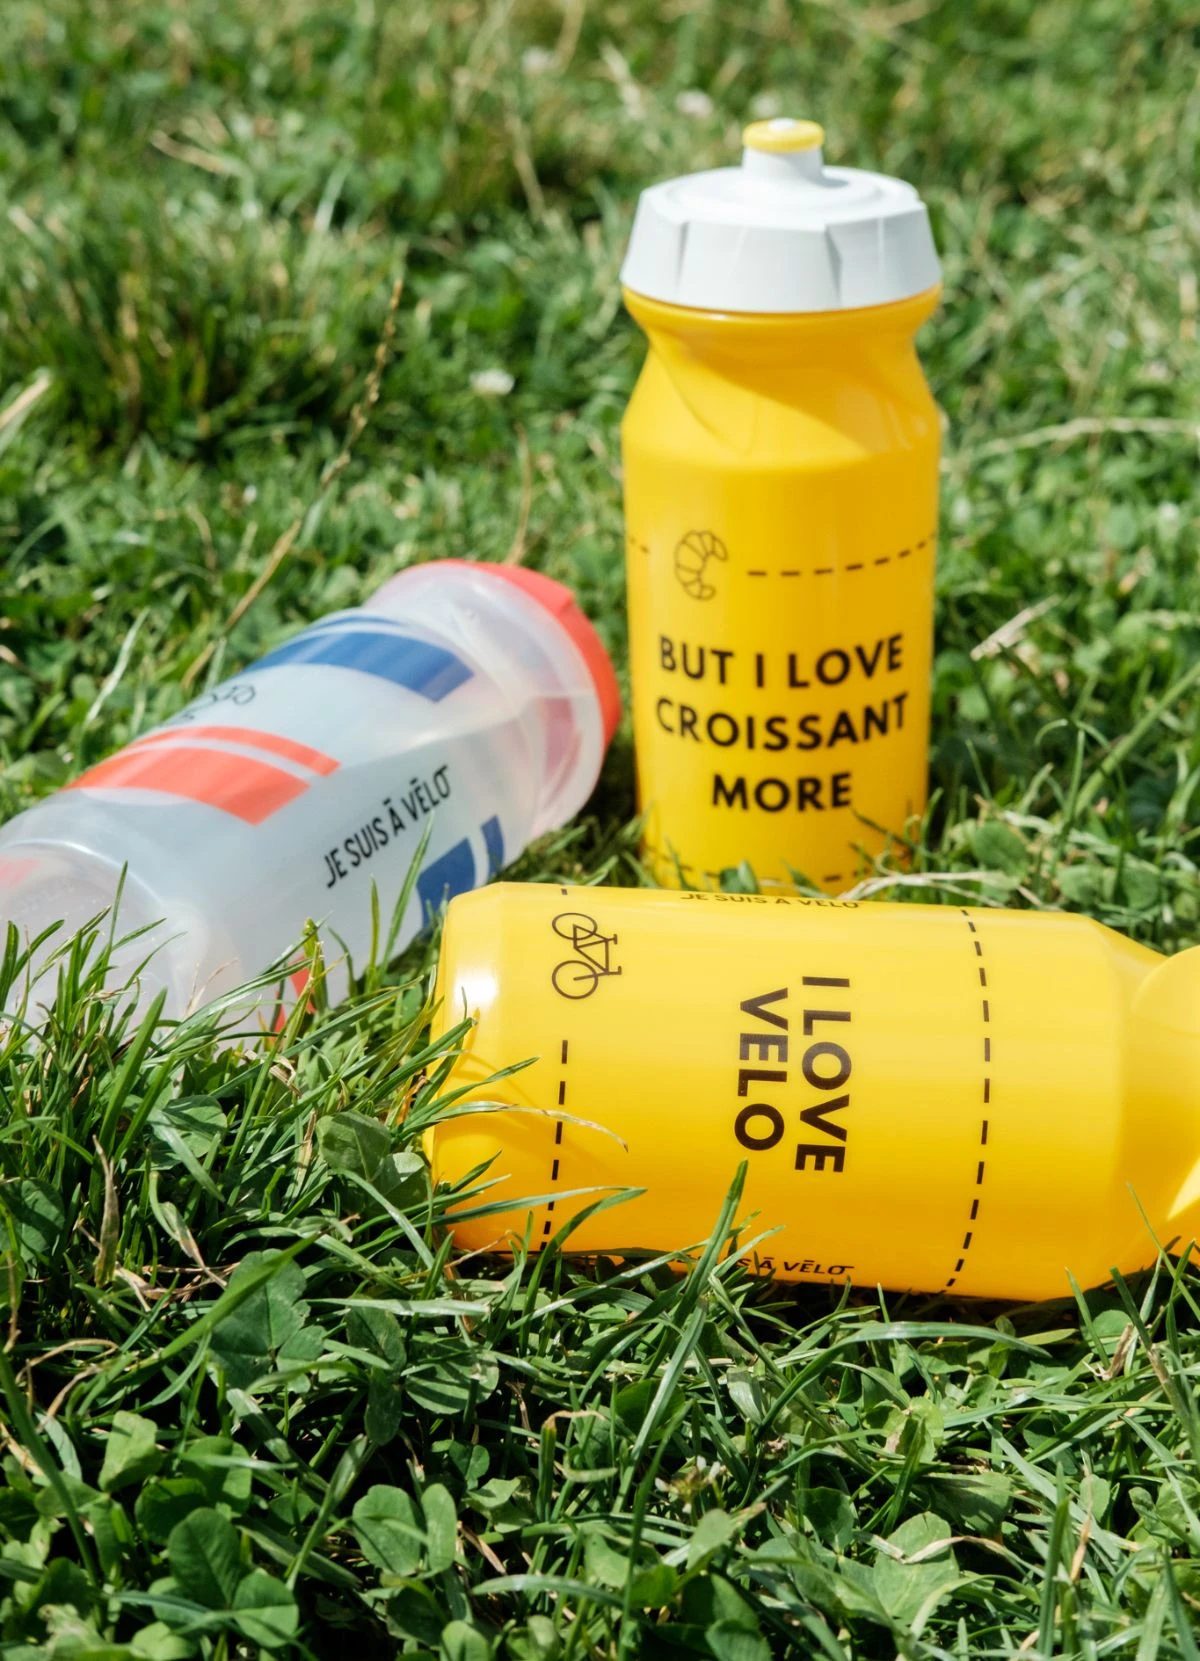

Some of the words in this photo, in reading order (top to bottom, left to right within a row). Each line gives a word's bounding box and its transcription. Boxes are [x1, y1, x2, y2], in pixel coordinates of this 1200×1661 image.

[660, 634, 733, 684] BUT
[756, 653, 764, 688] I
[788, 634, 904, 688] LOVE
[656, 692, 908, 750] CROISSANT
[713, 772, 853, 812] MORE
[324, 848, 348, 888] JE
[344, 816, 390, 868] SUIS
[680, 893, 708, 901] JE
[714, 895, 767, 904] SUIS
[802, 976, 850, 988] I
[734, 987, 789, 1151] VELO
[795, 1009, 852, 1172] LOVE
